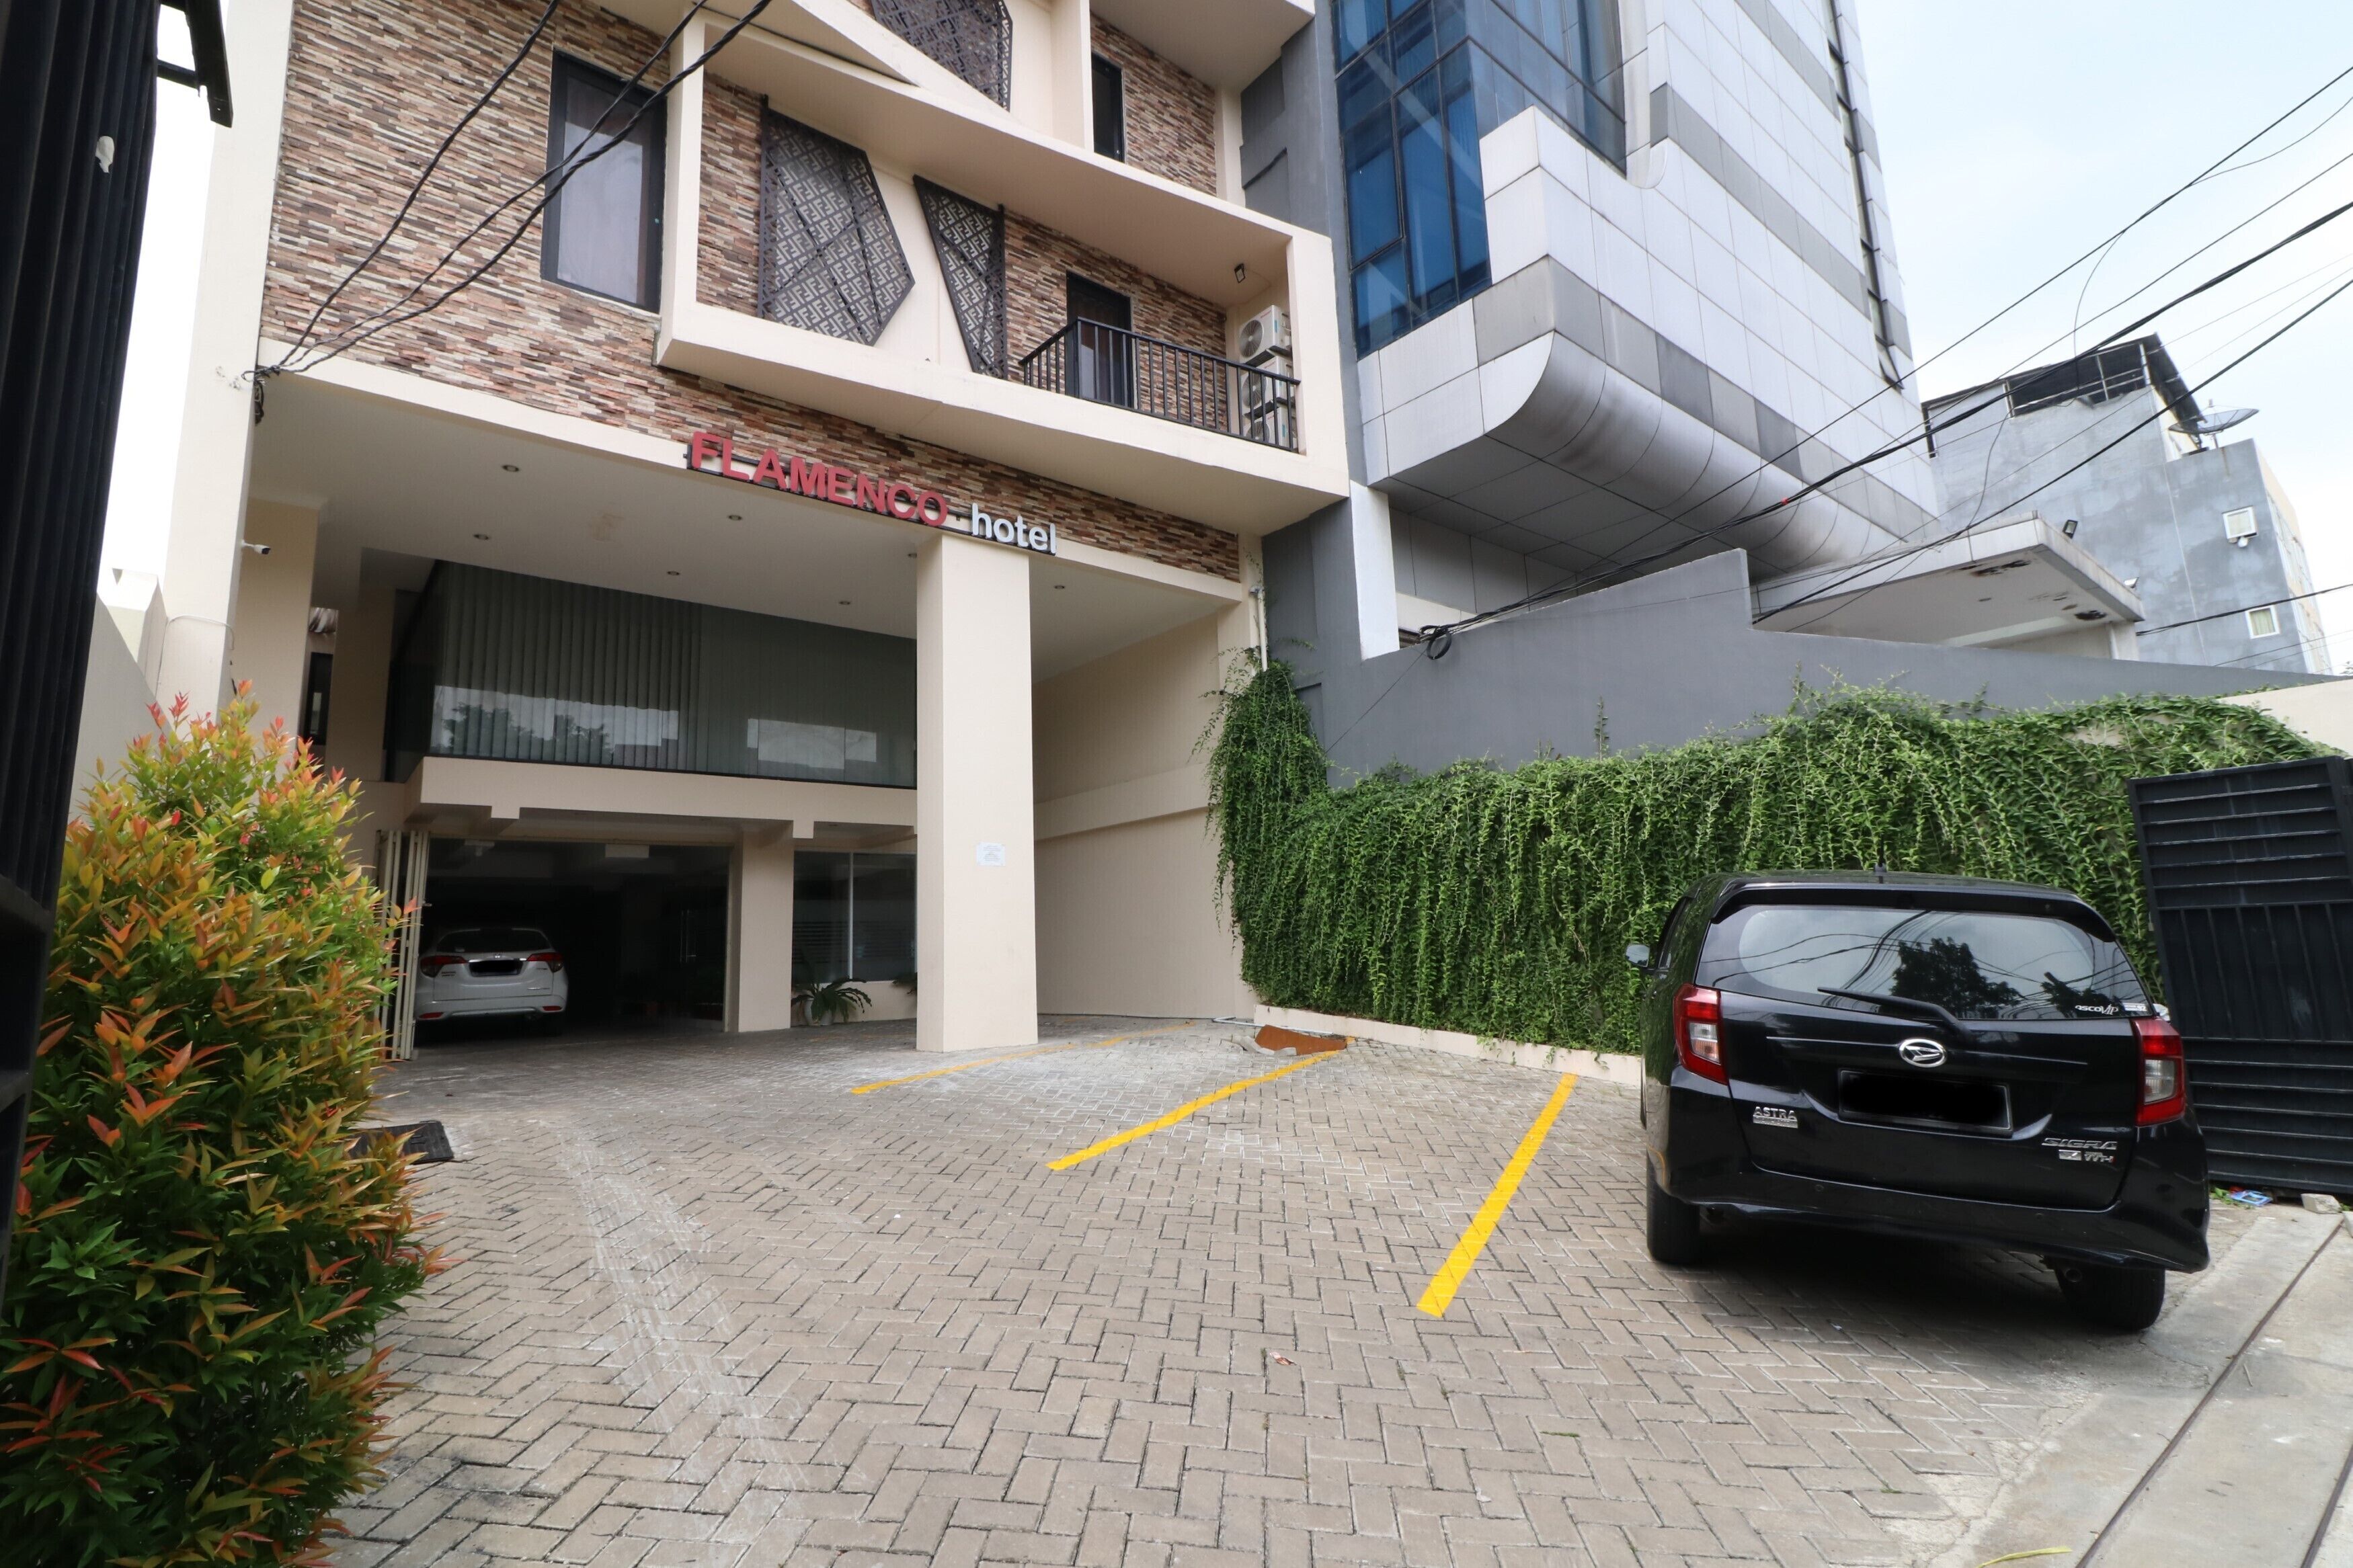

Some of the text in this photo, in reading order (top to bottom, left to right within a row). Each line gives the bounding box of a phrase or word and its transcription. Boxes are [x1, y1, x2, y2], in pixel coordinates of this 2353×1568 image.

[690, 431, 1057, 554] FLAMENCO hotel
[1753, 1106, 1798, 1122] ASTRA
[2041, 1137, 2118, 1150] SIGRA
